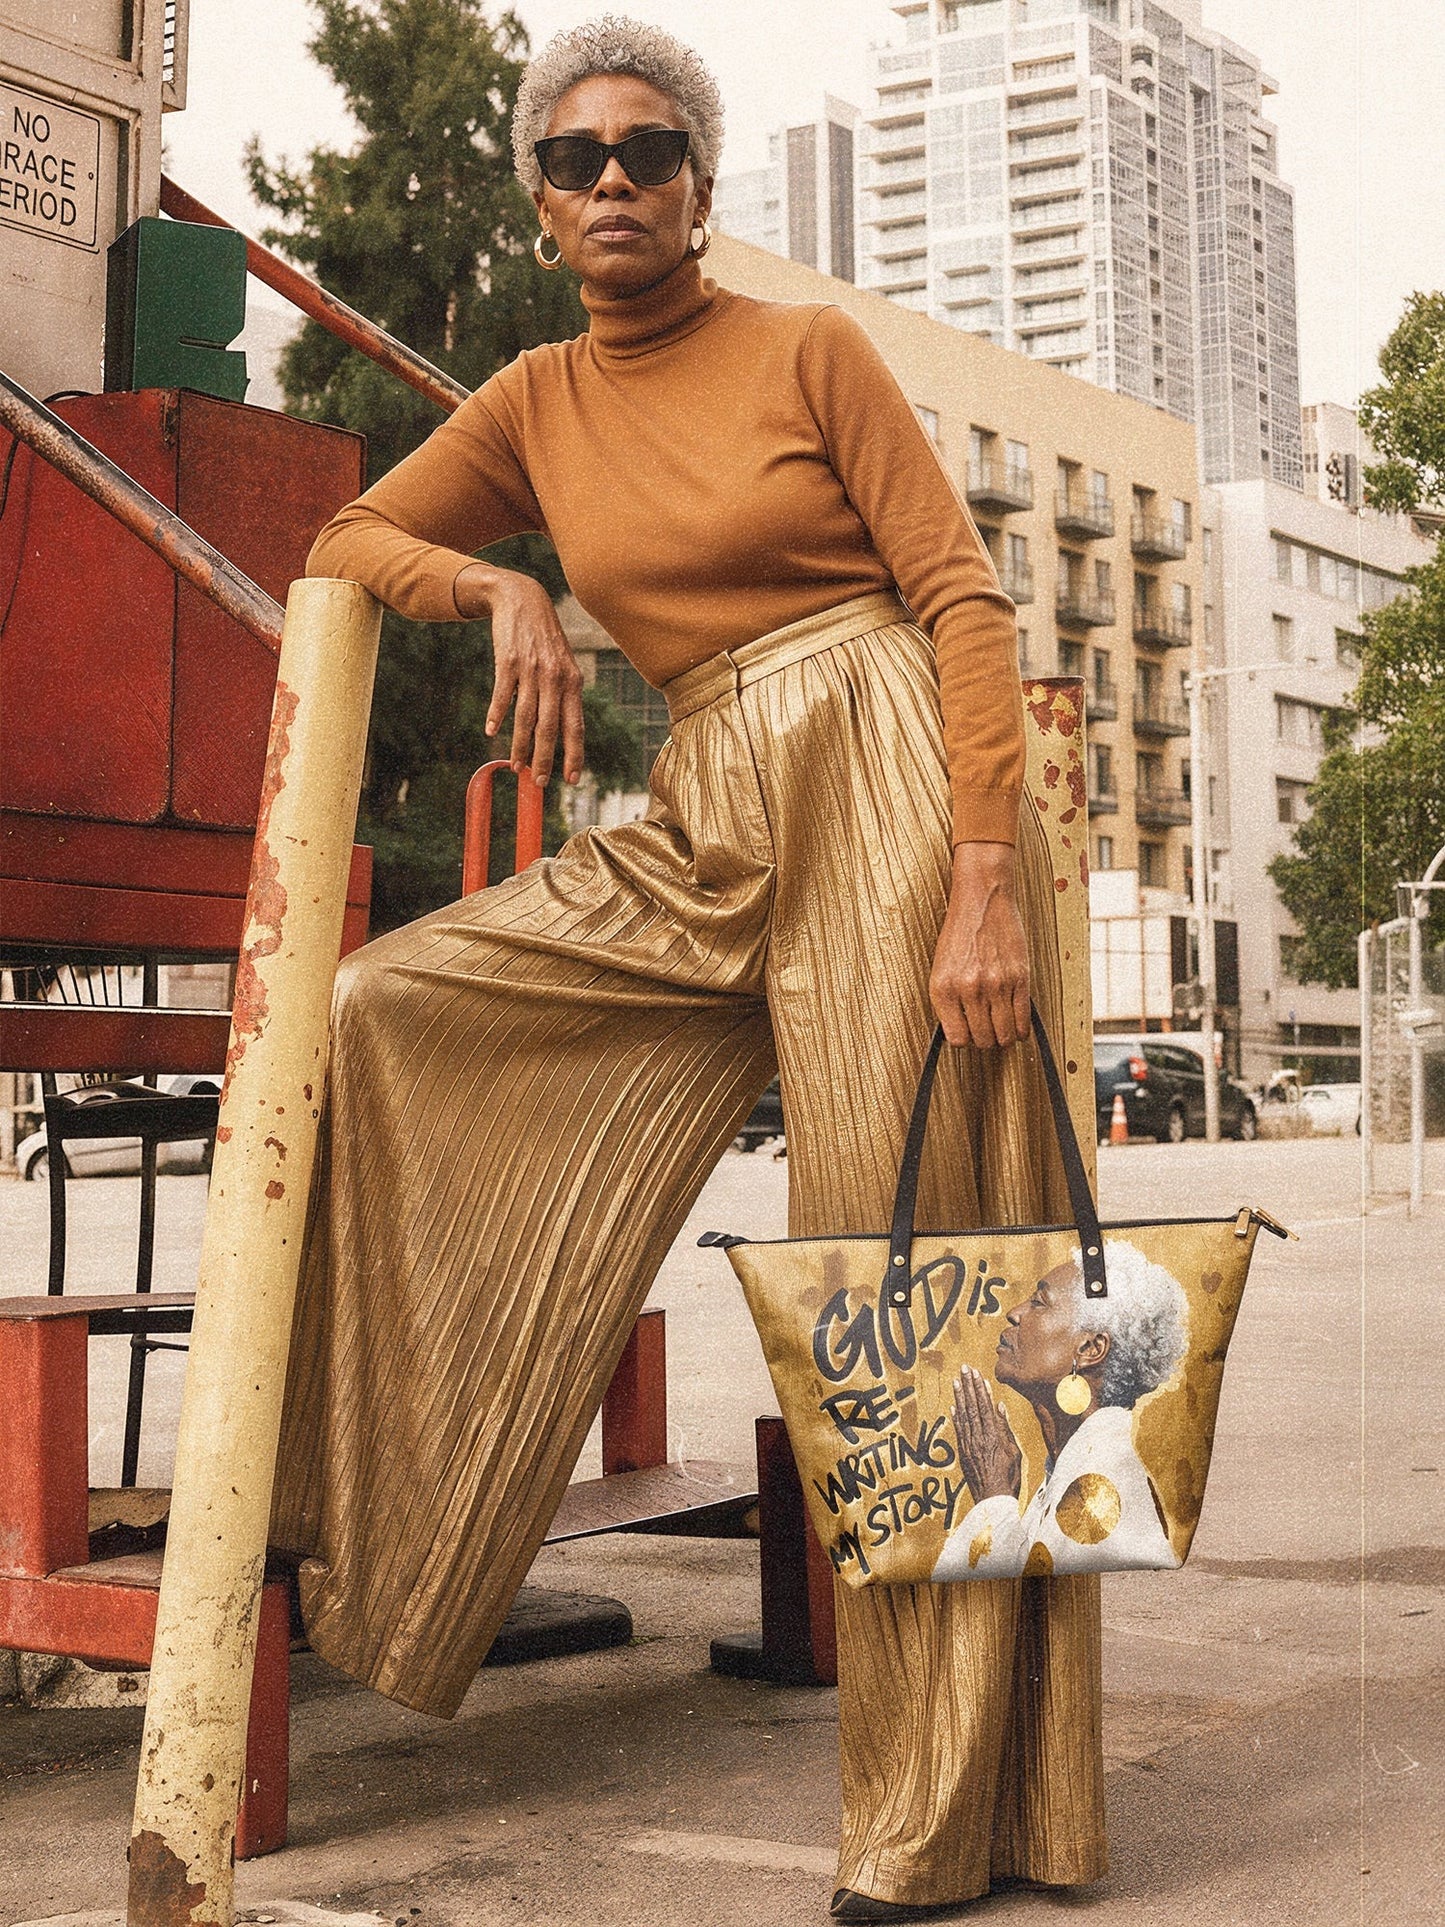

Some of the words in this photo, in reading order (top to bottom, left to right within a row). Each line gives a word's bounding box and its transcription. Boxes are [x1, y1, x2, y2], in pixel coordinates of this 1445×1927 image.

[14, 106, 50, 143] NO
[0, 141, 76, 191] RACE
[967, 1259, 1006, 1316] is
[821, 1385, 914, 1443] RE-
[814, 1417, 954, 1513] WRITING
[829, 1522, 870, 1575] MY
[867, 1477, 967, 1546] STORY
